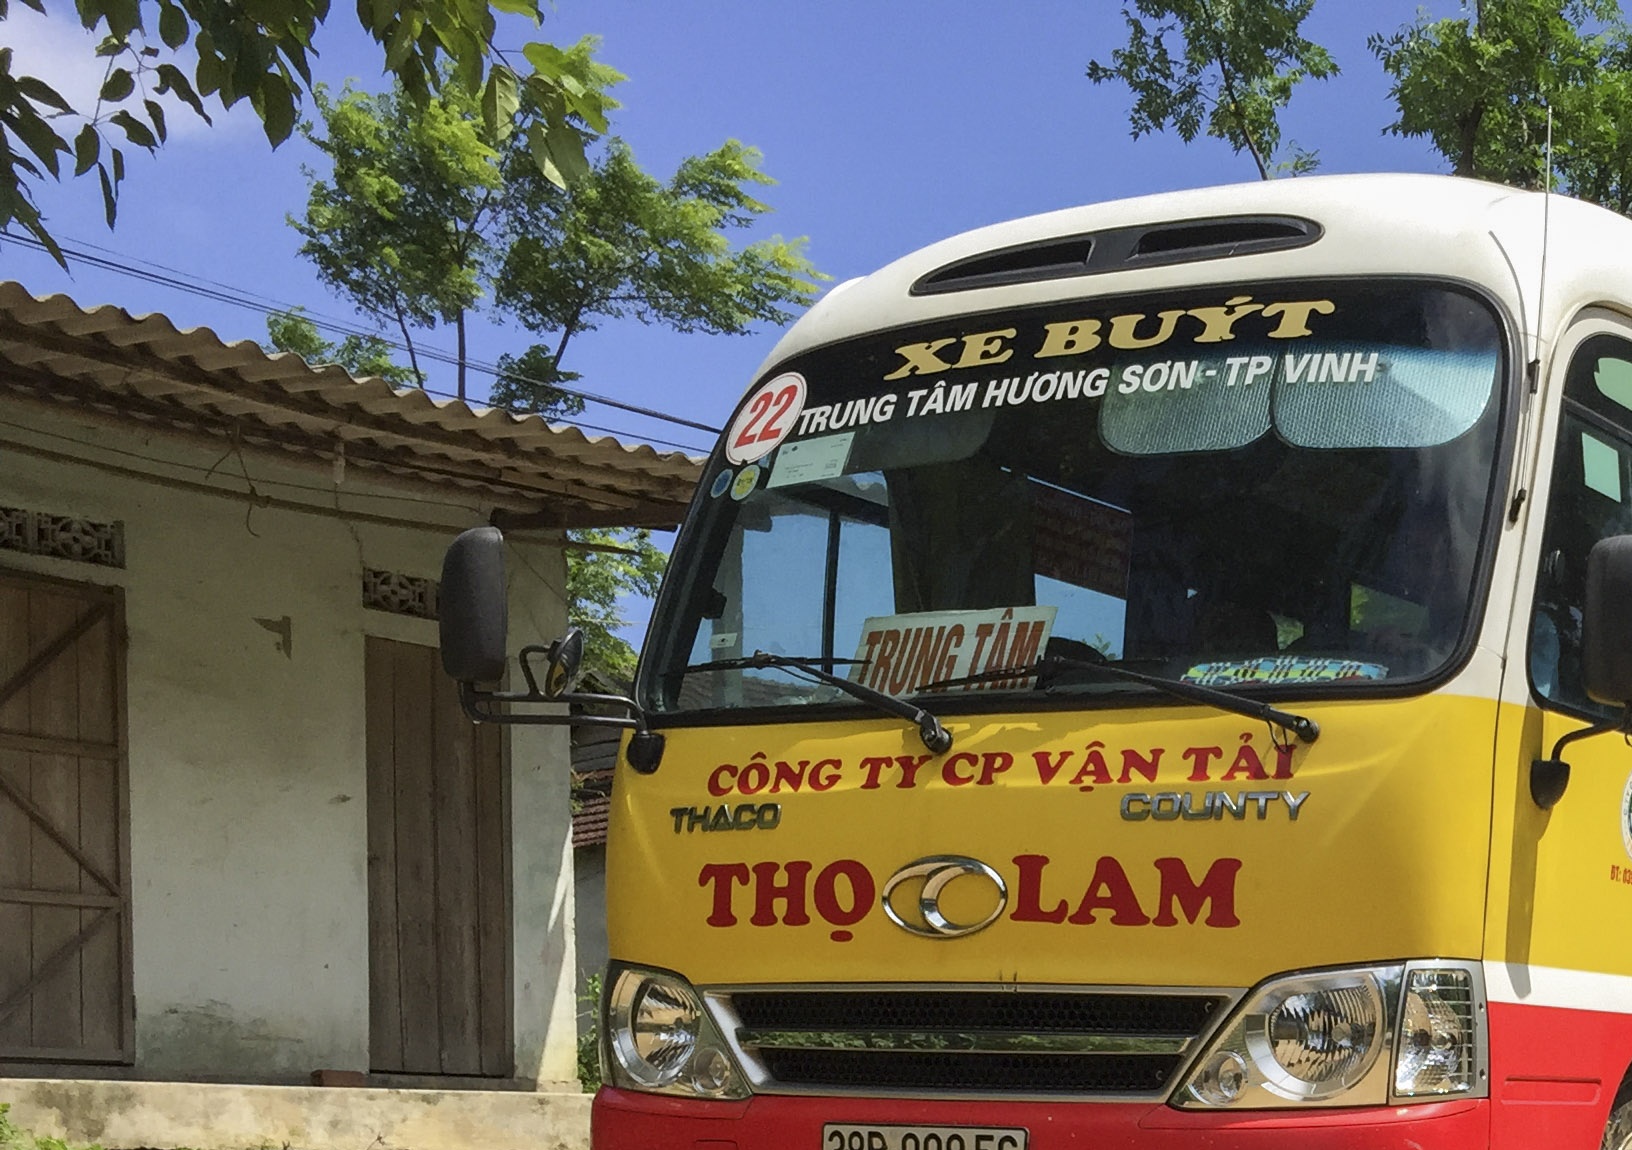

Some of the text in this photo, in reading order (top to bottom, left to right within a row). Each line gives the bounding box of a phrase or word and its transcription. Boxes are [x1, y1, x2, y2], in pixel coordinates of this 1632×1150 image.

[884, 296, 1335, 381] XE BUÝT
[733, 384, 799, 449] 22
[797, 393, 898, 436] TRUNG
[906, 380, 979, 418] TÂM
[982, 368, 1108, 409] HƯƠNG
[1118, 358, 1198, 394] SƠN
[1225, 356, 1271, 387] TP
[1283, 353, 1378, 384] VINH
[858, 607, 1046, 696] TRUNG TÂM
[707, 732, 1298, 797] CÔNG TY CP VẬN TẢI
[669, 803, 782, 834] THACO
[1120, 790, 1310, 821] COUNTY
[698, 854, 1244, 942] THỌ LAM
